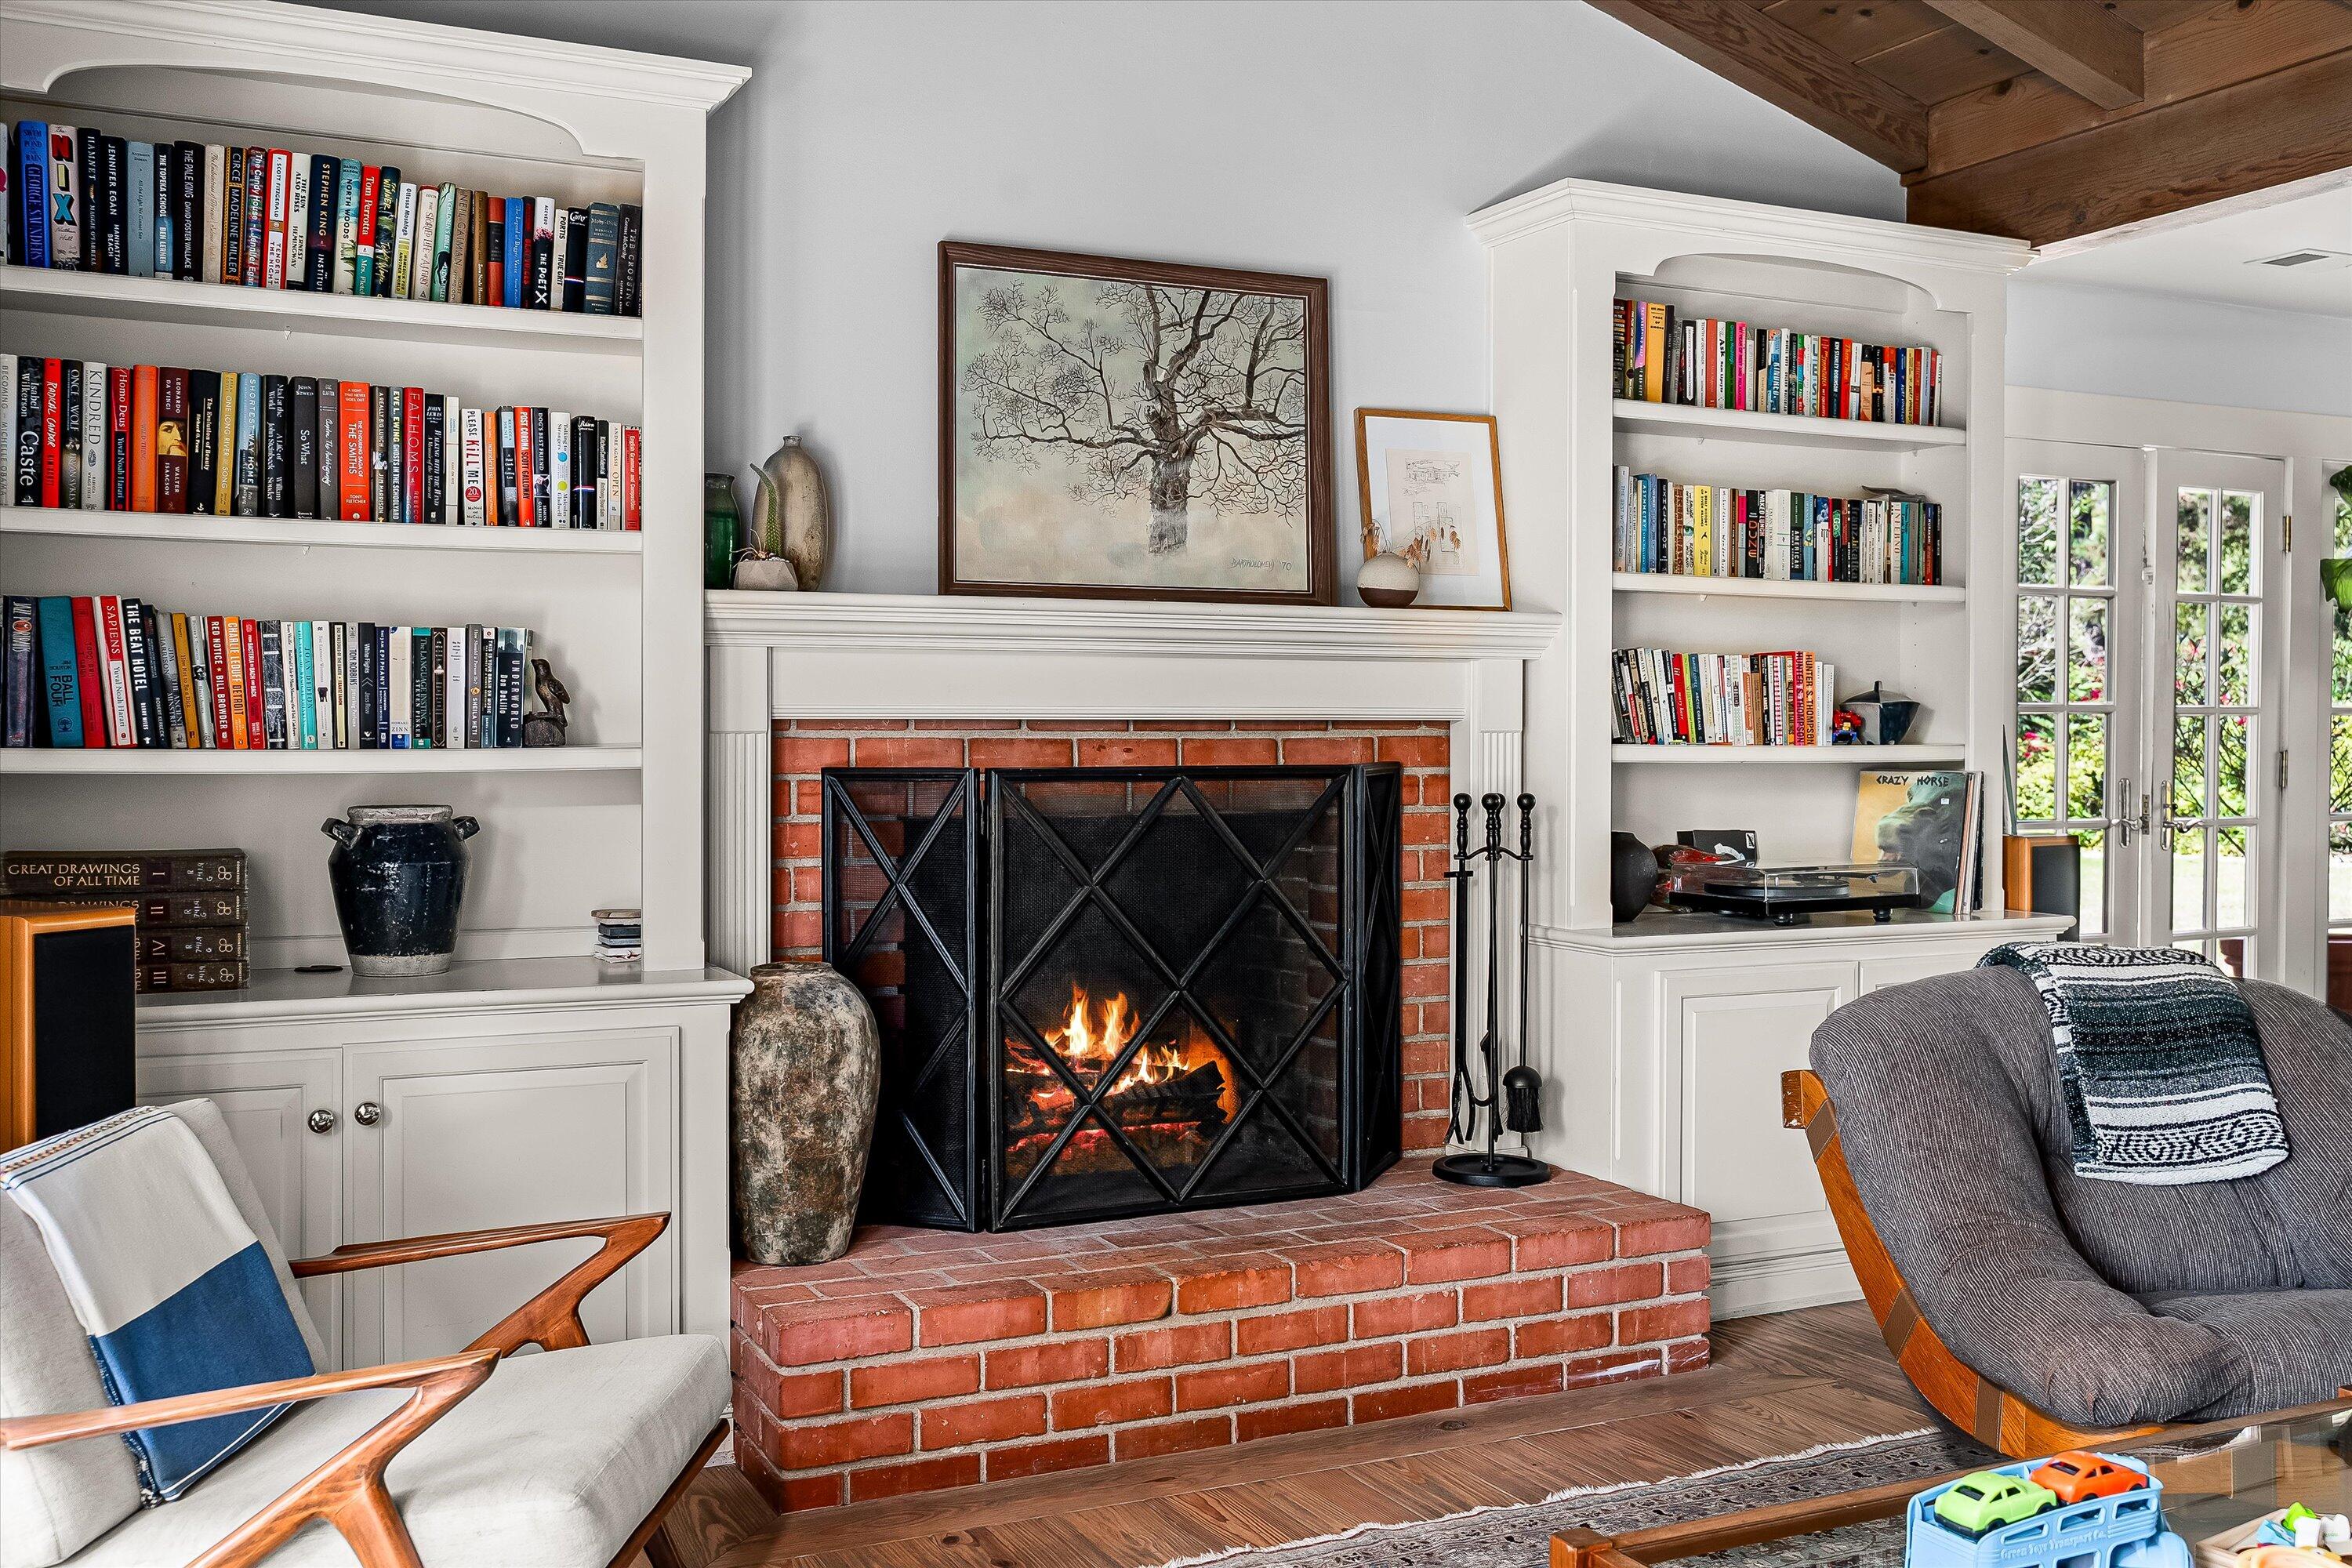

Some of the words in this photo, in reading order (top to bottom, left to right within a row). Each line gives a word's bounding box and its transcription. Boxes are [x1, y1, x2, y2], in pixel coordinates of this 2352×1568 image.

[87, 136, 96, 180] HAMNET
[108, 143, 117, 187] JENNIFER
[52, 134, 77, 226] NIX
[253, 169, 263, 195] Candy
[321, 164, 329, 206] STEPHEN
[365, 176, 375, 196] Tom
[230, 189, 239, 239] MADELINE
[362, 198, 373, 235] Perrotta
[459, 194, 468, 217] NEIL
[319, 212, 328, 236] KING
[229, 241, 238, 274] MILLER
[249, 234, 257, 264] Jennifer
[453, 222, 465, 267] GAIMAN
[538, 265, 546, 290] POET
[535, 291, 547, 304] X
[20, 373, 30, 417] Wilkerson
[31, 383, 40, 408] Isabel
[46, 380, 58, 416] RADICAL
[118, 375, 127, 401] Homo
[166, 380, 171, 389] DA
[88, 371, 102, 445] KINDRED
[118, 405, 127, 427] Deus
[248, 379, 256, 430] SHORTEST
[46, 418, 56, 448] CANDOR
[300, 430, 309, 441] So
[407, 393, 419, 473] FATHOMS
[466, 411, 477, 436] PLEASE
[20, 431, 39, 486] Caste
[300, 443, 310, 465] What
[467, 470, 479, 485] ME
[522, 470, 531, 499] GALLOWAY
[126, 604, 140, 623] THE
[107, 605, 120, 655] SAPIENS
[129, 628, 143, 654] BEAT
[211, 621, 220, 636] RED
[227, 622, 239, 654] CHARLIE
[212, 638, 223, 665] NOTICE
[132, 658, 147, 691] HOTEL
[216, 675, 224, 691] BILL
[230, 657, 241, 683] LEDUFF
[50, 675, 62, 707] FOUR
[62, 675, 74, 704] BALL
[232, 685, 244, 715] DETROIT
[499, 691, 508, 714] DeLillo
[511, 660, 521, 729] UNDERWORLD
[217, 693, 227, 730] BROWDER
[1876, 775, 1909, 786] CRAZY
[1917, 776, 1949, 787] HORSE
[9, 865, 54, 875] GREAT
[59, 863, 140, 874] DRAWINGS
[54, 877, 73, 886] OF
[77, 876, 101, 886] ALL
[107, 876, 140, 886] TIME
[152, 940, 165, 955] IV
